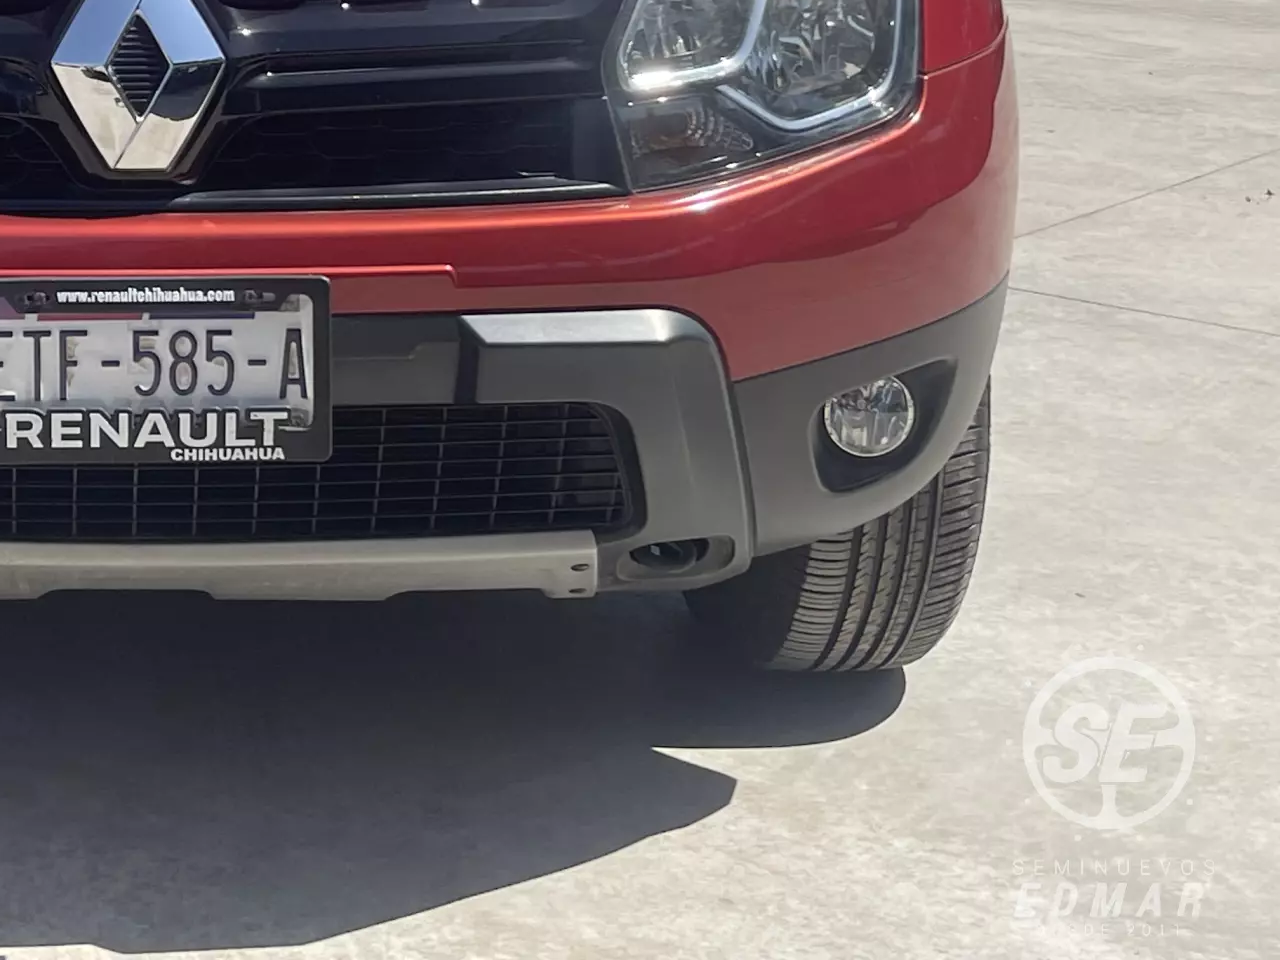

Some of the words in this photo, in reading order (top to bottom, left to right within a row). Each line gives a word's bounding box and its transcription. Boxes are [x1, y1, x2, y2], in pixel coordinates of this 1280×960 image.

[56, 287, 235, 304] www.renaultchihuahua.com
[4, 411, 289, 449] RENAULT
[170, 447, 286, 461] CHIHUAHUA
